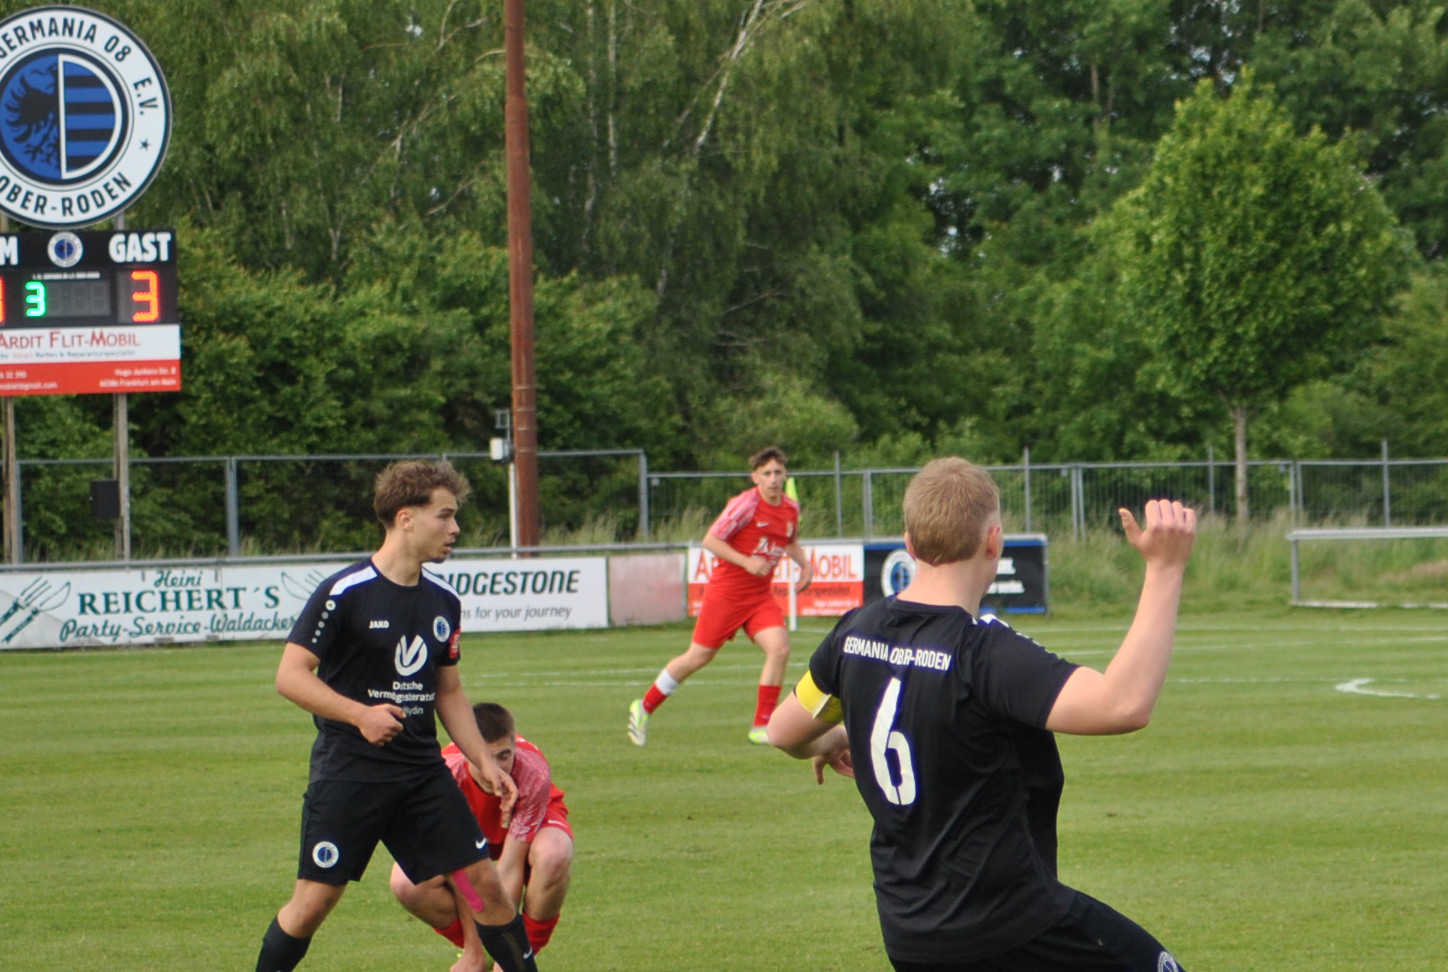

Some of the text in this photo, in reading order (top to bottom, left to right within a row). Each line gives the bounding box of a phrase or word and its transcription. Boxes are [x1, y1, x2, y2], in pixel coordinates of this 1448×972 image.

[104, 35, 131, 63] 08
[133, 76, 159, 116] E.V.
[0, 171, 132, 217] OBER-RODEN
[109, 232, 172, 263] GAST
[25, 281, 46, 317] 3
[131, 270, 159, 322] 3
[153, 570, 202, 588] Heini
[369, 620, 390, 630] JAKO
[475, 606, 491, 620] for
[495, 608, 522, 622] your
[523, 604, 573, 621] journey
[843, 636, 889, 662] GERMANIA
[870, 677, 916, 806] 6
